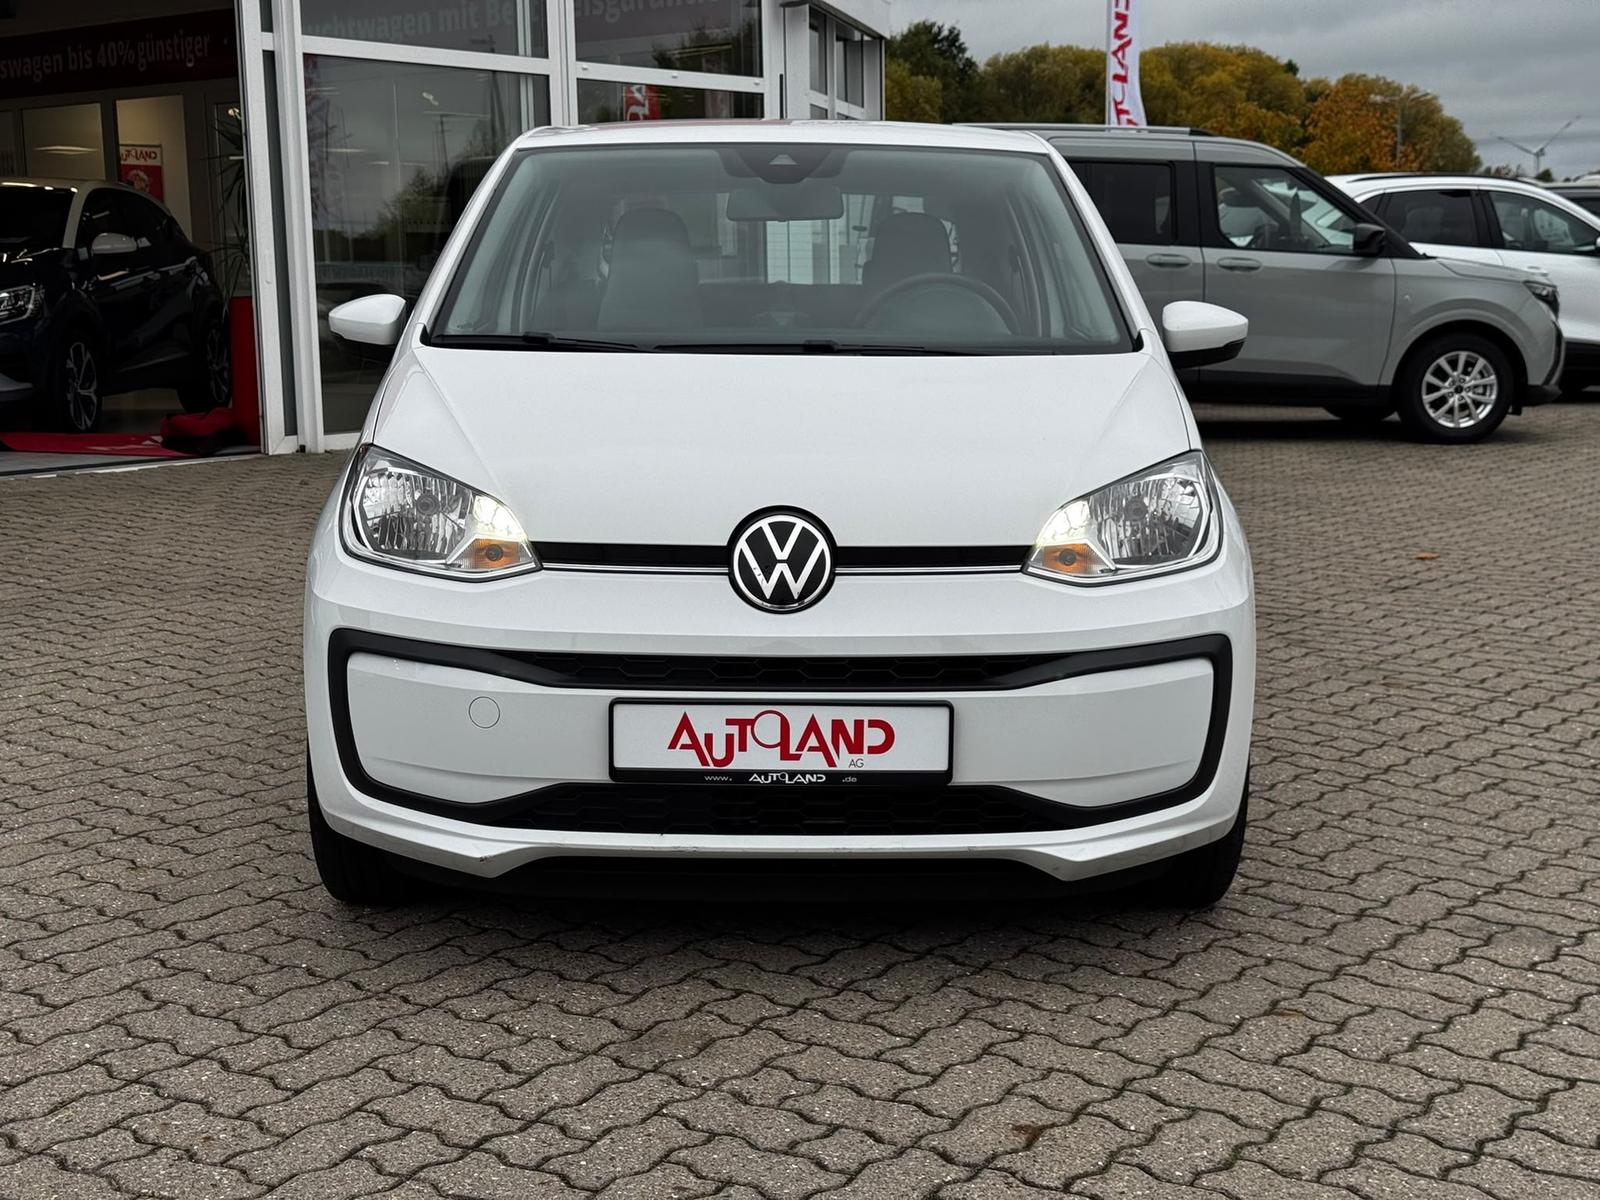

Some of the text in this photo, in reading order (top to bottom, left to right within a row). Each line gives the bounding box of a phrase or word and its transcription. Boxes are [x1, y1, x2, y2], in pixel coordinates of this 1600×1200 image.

[67, 43, 92, 71] bis
[97, 40, 135, 68] 40%
[137, 28, 210, 72] günstiger
[848, 758, 865, 769] AG
[842, 775, 858, 783] .de
